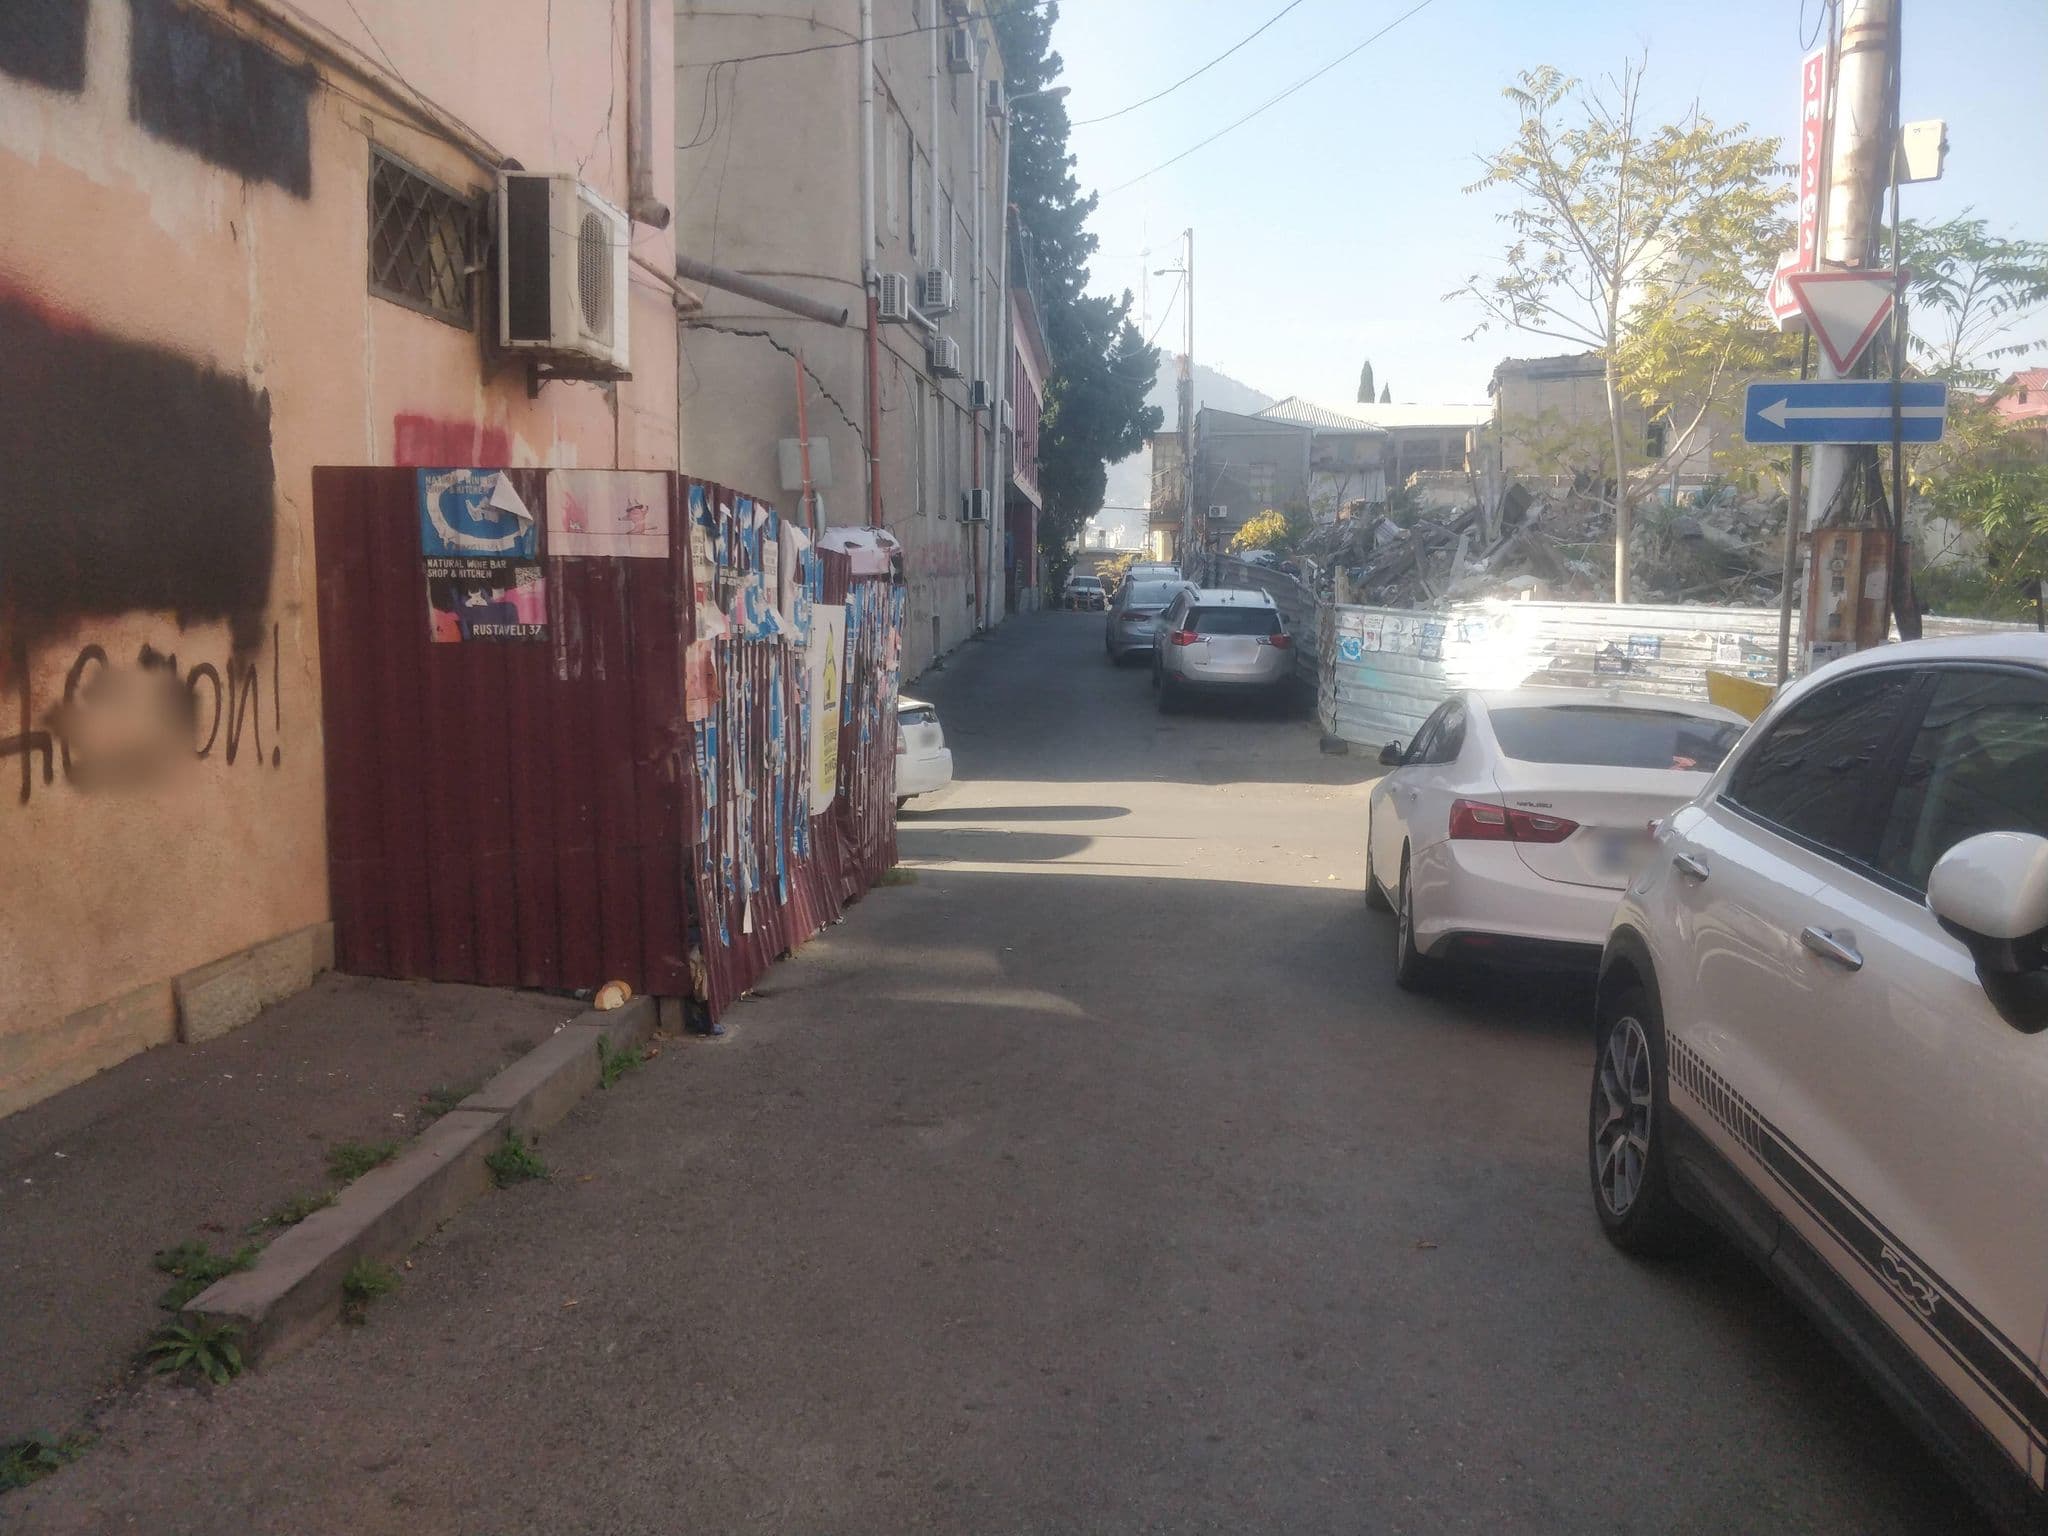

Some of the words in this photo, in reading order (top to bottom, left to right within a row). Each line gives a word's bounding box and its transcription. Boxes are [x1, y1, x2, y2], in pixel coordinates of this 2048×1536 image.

[427, 559, 464, 568] NATURAL
[466, 559, 488, 569] WINE
[489, 560, 507, 569] BAR
[427, 568, 448, 578] SHOP
[450, 569, 457, 578] &
[459, 569, 492, 578] KITCHEN
[472, 624, 526, 636] RUSTAVELI
[528, 624, 541, 635] 37
